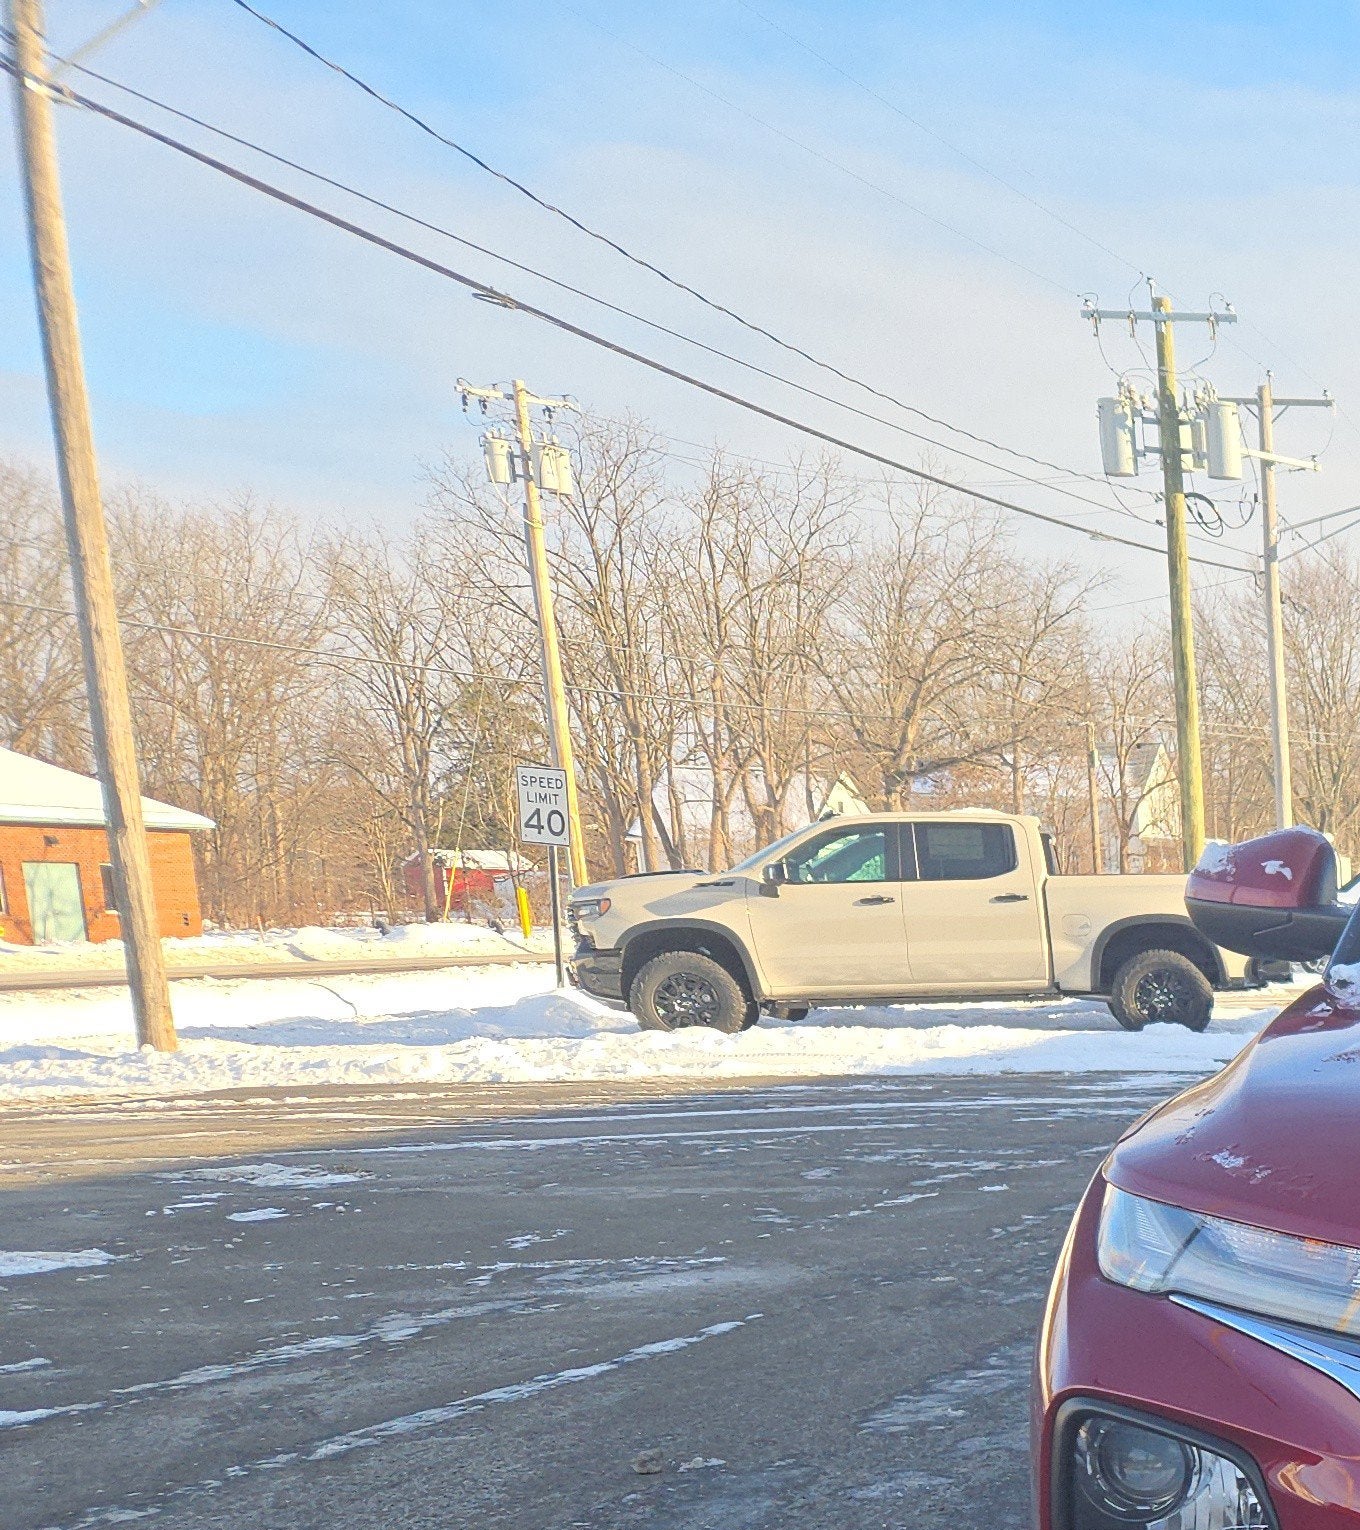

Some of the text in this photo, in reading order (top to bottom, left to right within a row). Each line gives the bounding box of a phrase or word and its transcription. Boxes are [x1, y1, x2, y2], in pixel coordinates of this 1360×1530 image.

[520, 774, 564, 790] SPEED
[526, 791, 560, 806] LIMIT
[523, 807, 566, 837] 40
